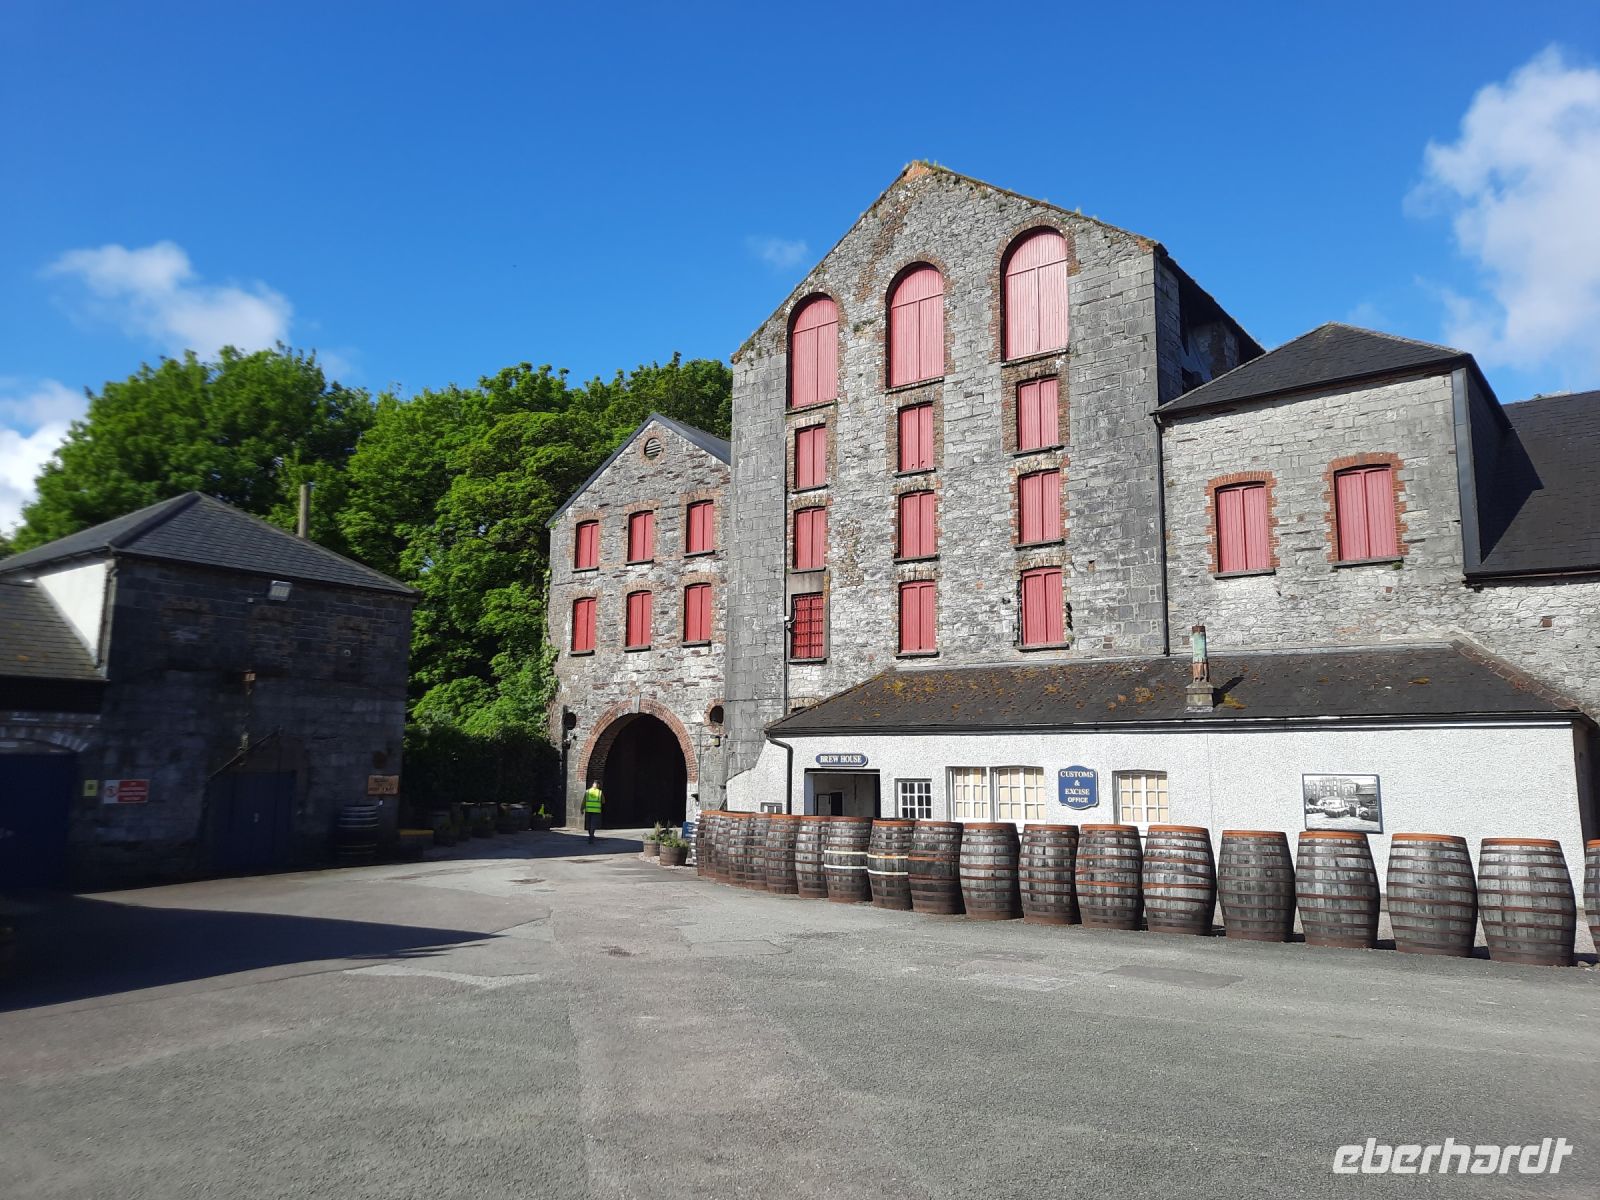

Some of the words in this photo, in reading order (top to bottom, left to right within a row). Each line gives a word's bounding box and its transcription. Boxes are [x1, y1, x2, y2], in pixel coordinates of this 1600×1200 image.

[820, 755, 839, 763] BREW
[840, 755, 862, 763] HOUSE
[1060, 770, 1094, 778] CUSTOMS
[1074, 779, 1081, 787] &
